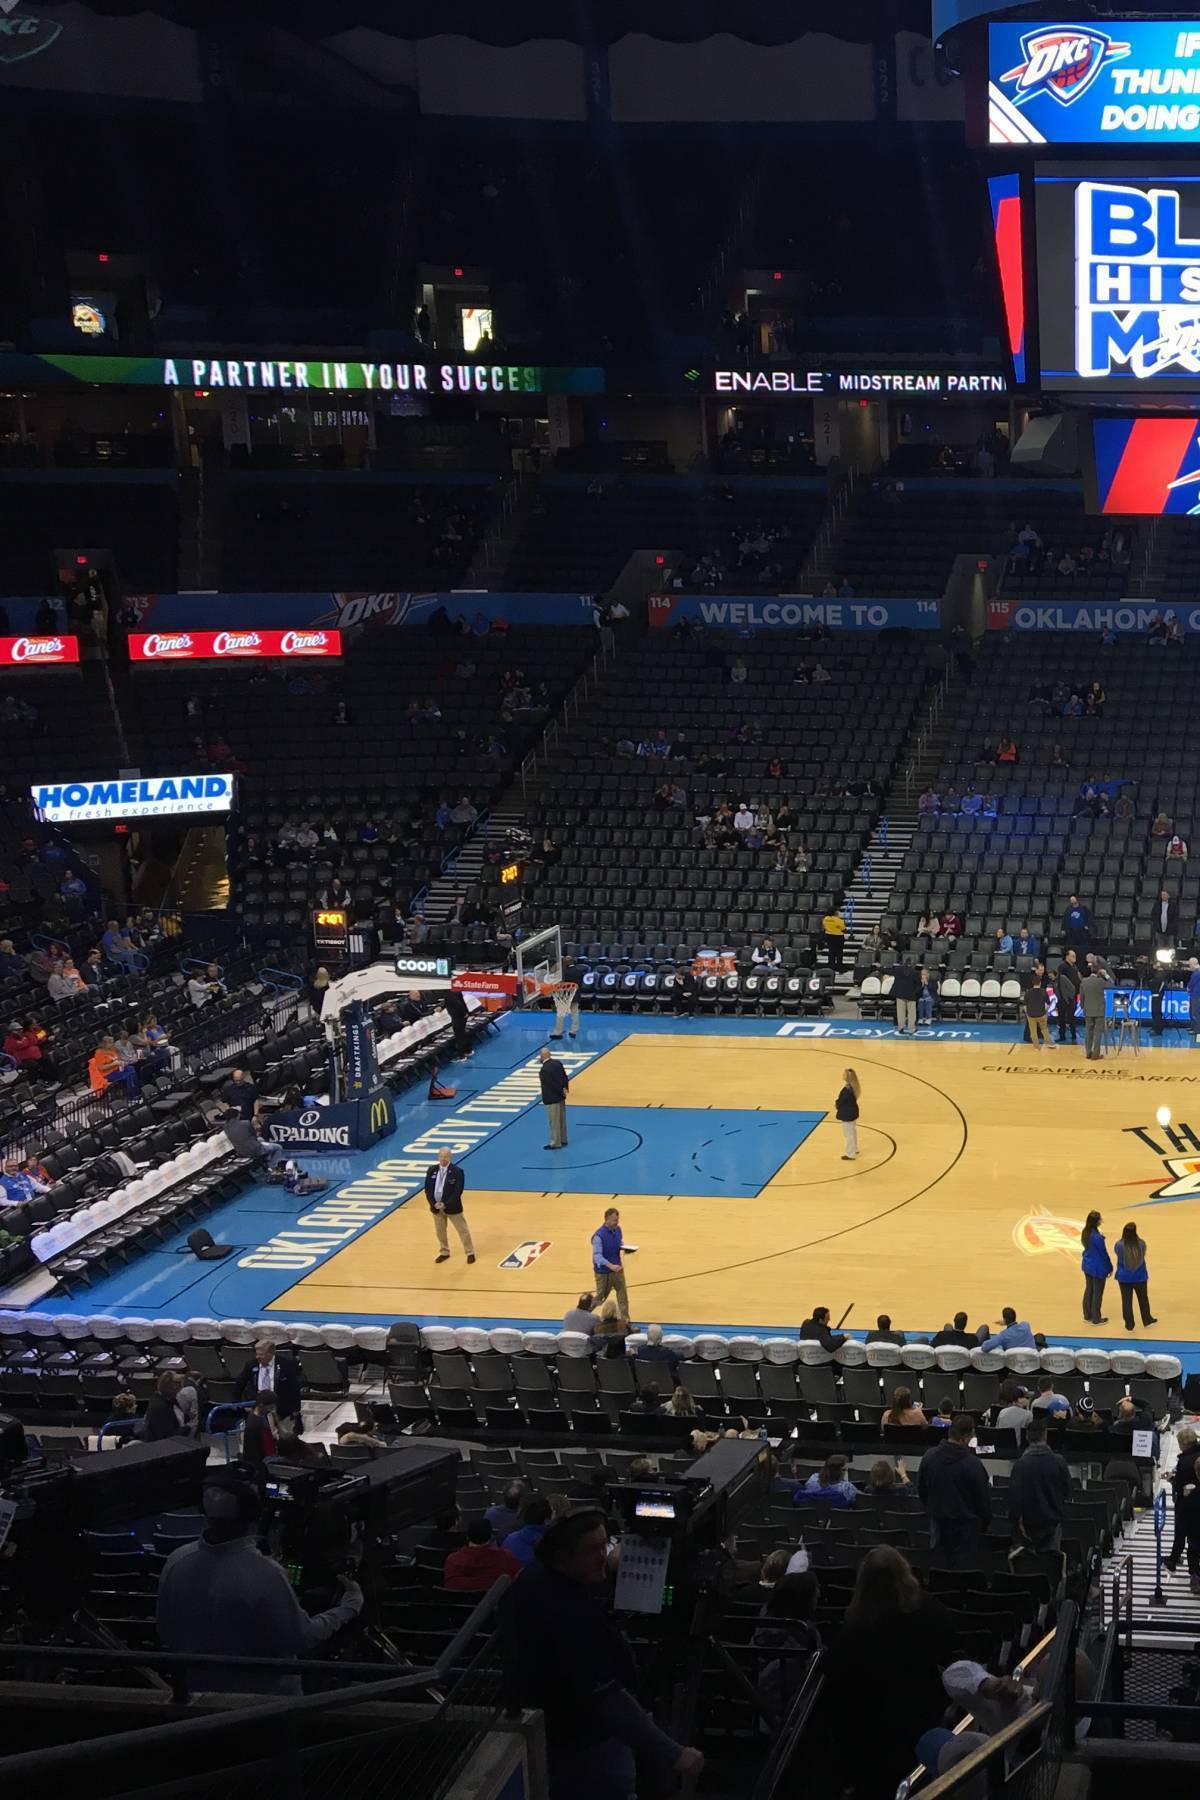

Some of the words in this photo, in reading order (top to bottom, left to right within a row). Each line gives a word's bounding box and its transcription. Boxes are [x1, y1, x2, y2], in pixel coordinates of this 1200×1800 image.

[1023, 37, 1092, 84] OKC
[1102, 105, 1200, 130] DOING
[164, 360, 179, 384] A
[193, 360, 309, 389] PARTNER
[322, 362, 348, 389] IN
[362, 363, 428, 392] YOUR
[714, 371, 824, 392] ENABLE
[838, 375, 941, 391] MIDSTREAM
[947, 376, 1007, 391] PARTN
[336, 593, 395, 627] OKC
[650, 597, 671, 608] 114
[916, 601, 937, 613] 114
[990, 602, 1009, 613] 115
[700, 603, 842, 625] WELCOME
[851, 605, 889, 626] TO
[1015, 607, 1177, 633] OKLAHOMA
[11, 637, 65, 661] Cane's
[143, 634, 194, 657] Cane's
[213, 632, 262, 654] Cane's
[280, 630, 329, 653] Cane's
[37, 776, 228, 809] HOMELAND
[69, 807, 112, 820] fresh
[122, 801, 214, 819] experience
[397, 959, 437, 973] COOP
[583, 973, 594, 985] G
[604, 974, 615, 986] G
[625, 974, 636, 986] G
[645, 975, 656, 987] G
[664, 975, 675, 987] G
[706, 977, 717, 988] G
[726, 977, 738, 988] G
[746, 977, 757, 989] G
[767, 978, 778, 990] G
[788, 978, 800, 990] G
[809, 979, 820, 990] G
[352, 1024, 362, 1078] DRAFTKINGS
[982, 1065, 1129, 1077] CHESAPEAKE
[269, 1124, 350, 1146] SPALDING
[402, 1118, 503, 1155] CITY
[237, 1159, 438, 1270] OKLAHOMA
